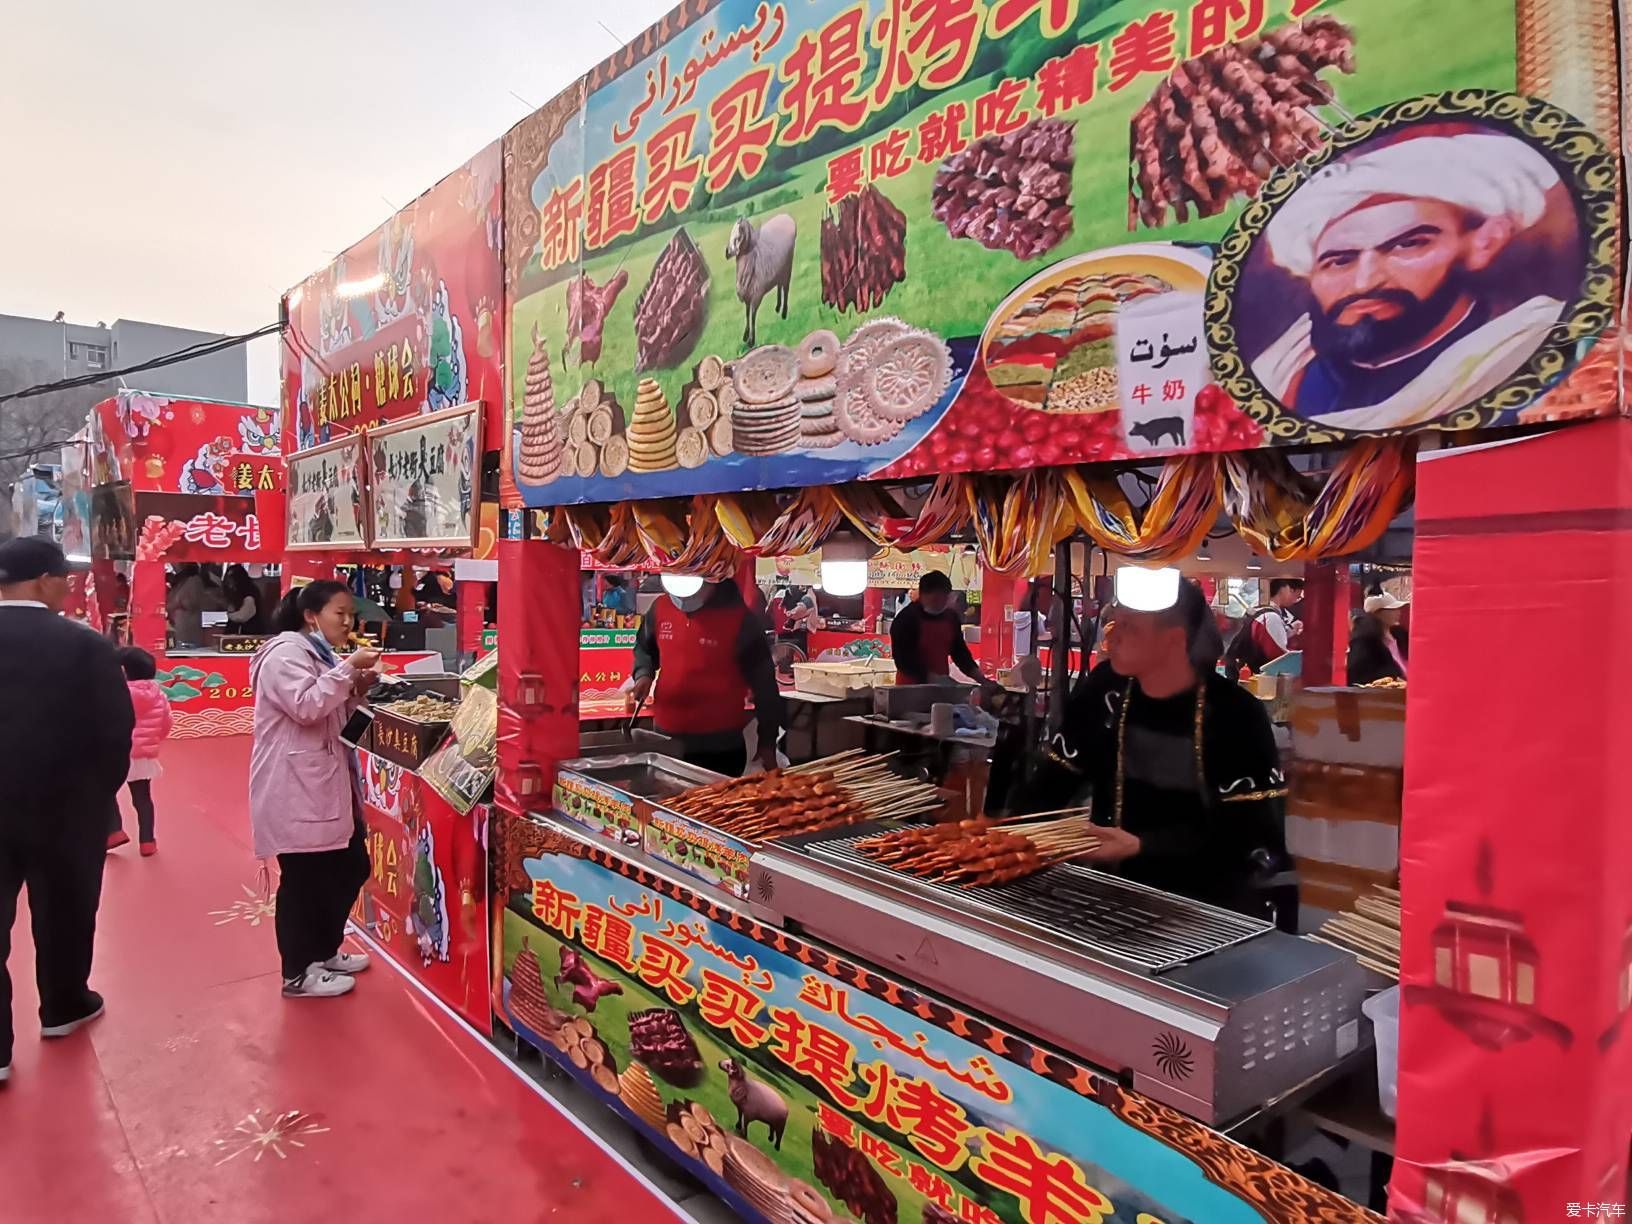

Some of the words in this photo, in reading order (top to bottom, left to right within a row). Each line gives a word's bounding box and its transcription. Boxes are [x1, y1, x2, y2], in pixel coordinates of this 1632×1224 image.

[825, 0, 1317, 206] 要吃就吃精美的
[1132, 379, 1185, 405] 牛奶
